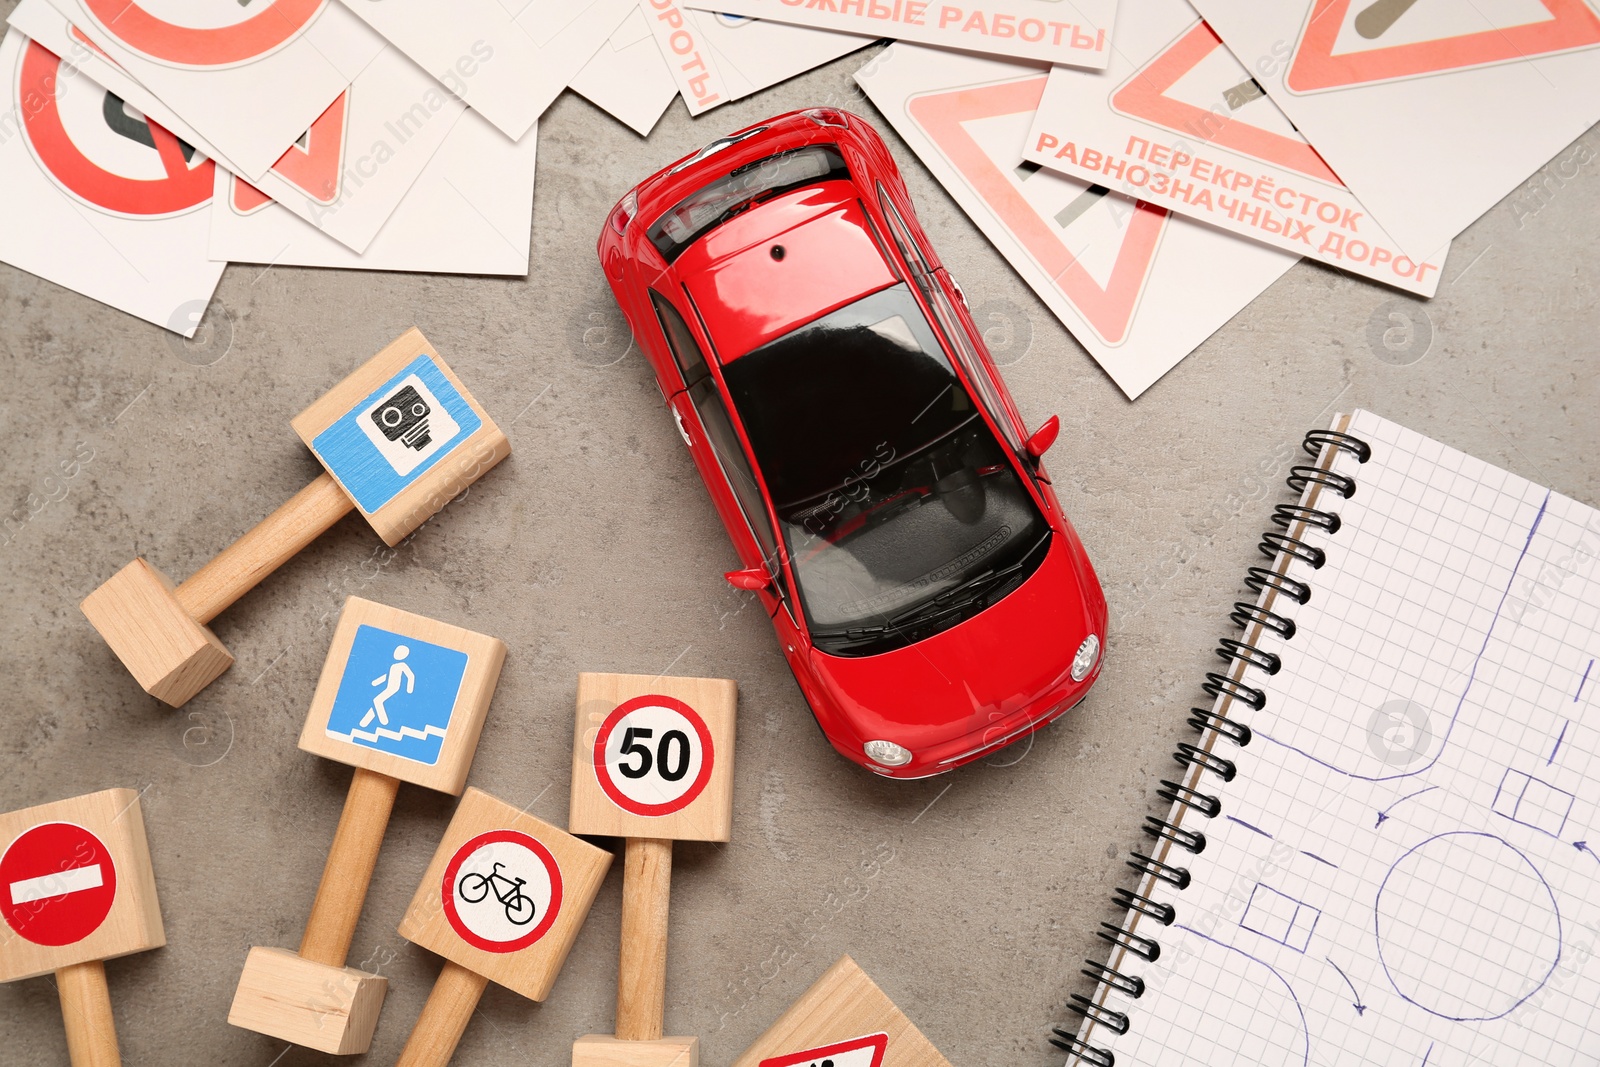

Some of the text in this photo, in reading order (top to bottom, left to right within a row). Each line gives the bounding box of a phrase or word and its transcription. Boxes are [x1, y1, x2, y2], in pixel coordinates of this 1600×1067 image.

[938, 5, 1106, 52] РАБОТЫ
[1035, 132, 1438, 283] РАВНОЗНАЧНЫХ ДОРОГ
[1125, 135, 1364, 232] ПЕРЕКРЁСТОК
[618, 727, 691, 782] 50
